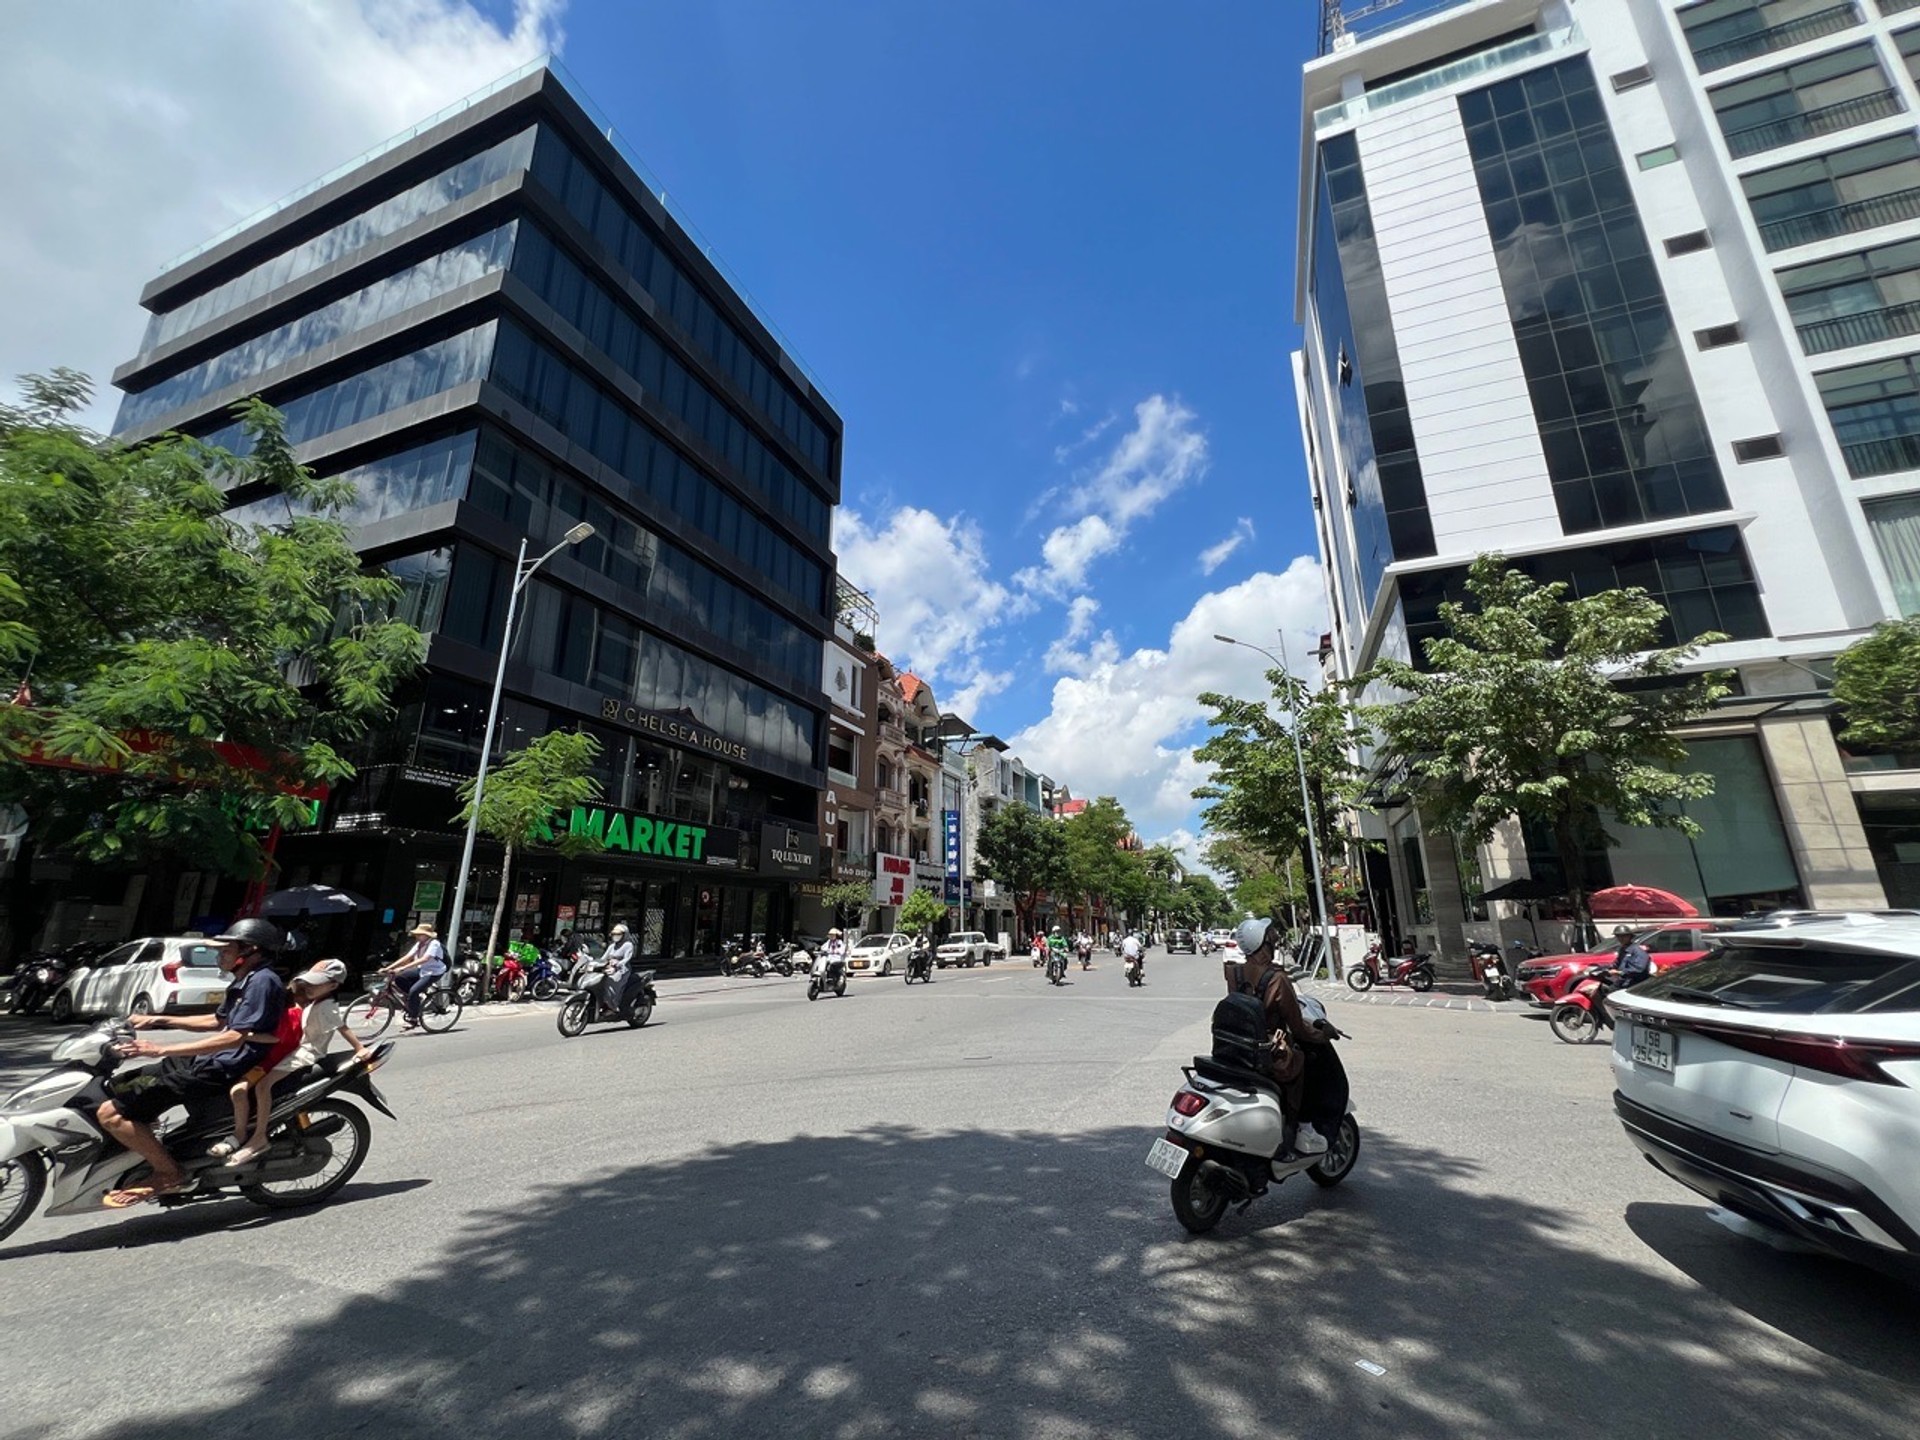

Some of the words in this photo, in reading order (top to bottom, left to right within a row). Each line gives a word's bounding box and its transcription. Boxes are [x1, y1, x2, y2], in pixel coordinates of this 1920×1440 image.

[624, 707, 698, 744] CHELSEA
[703, 734, 748, 760] HOUSE
[771, 849, 783, 863] TQ
